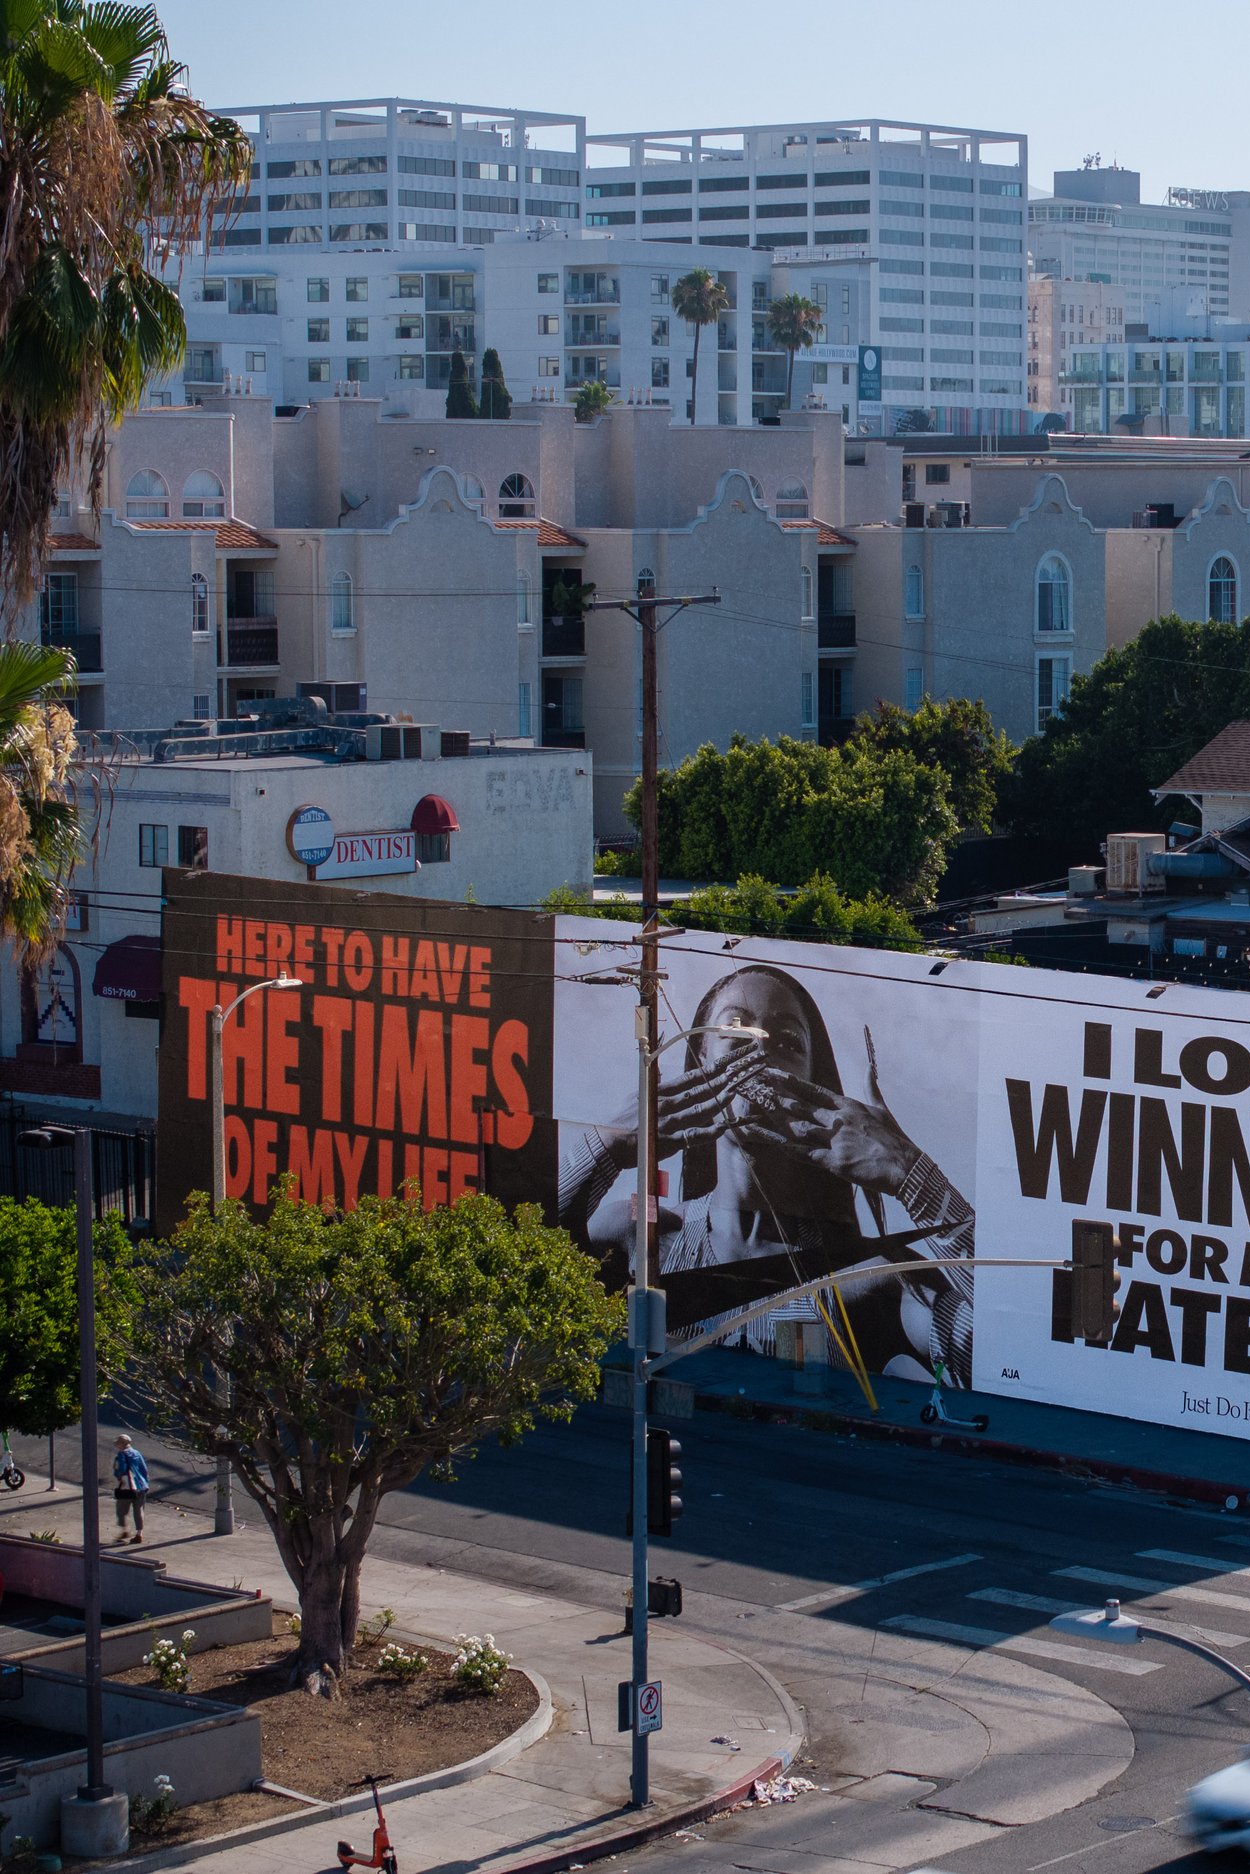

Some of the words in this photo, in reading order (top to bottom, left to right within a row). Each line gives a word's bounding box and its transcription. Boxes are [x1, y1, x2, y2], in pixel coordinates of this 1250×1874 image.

[1169, 187, 1229, 212] LOEWS
[300, 810, 326, 823] DENTIST
[301, 849, 327, 861] 851-7140
[336, 835, 414, 864] DENTIST
[216, 913, 315, 984] HERE
[322, 927, 374, 992] TO
[381, 934, 492, 1008] HAVE
[102, 986, 137, 999] 851-7140
[179, 976, 301, 1115] THE
[313, 994, 534, 1150] TIMES
[1083, 1021, 1112, 1080] I
[223, 1114, 278, 1205] OF
[288, 1124, 370, 1214] MY
[1118, 1223, 1230, 1284] FOR
[1001, 1367, 1020, 1381] A'JA
[1181, 1391, 1211, 1415] Just
[1216, 1396, 1241, 1419] Do
